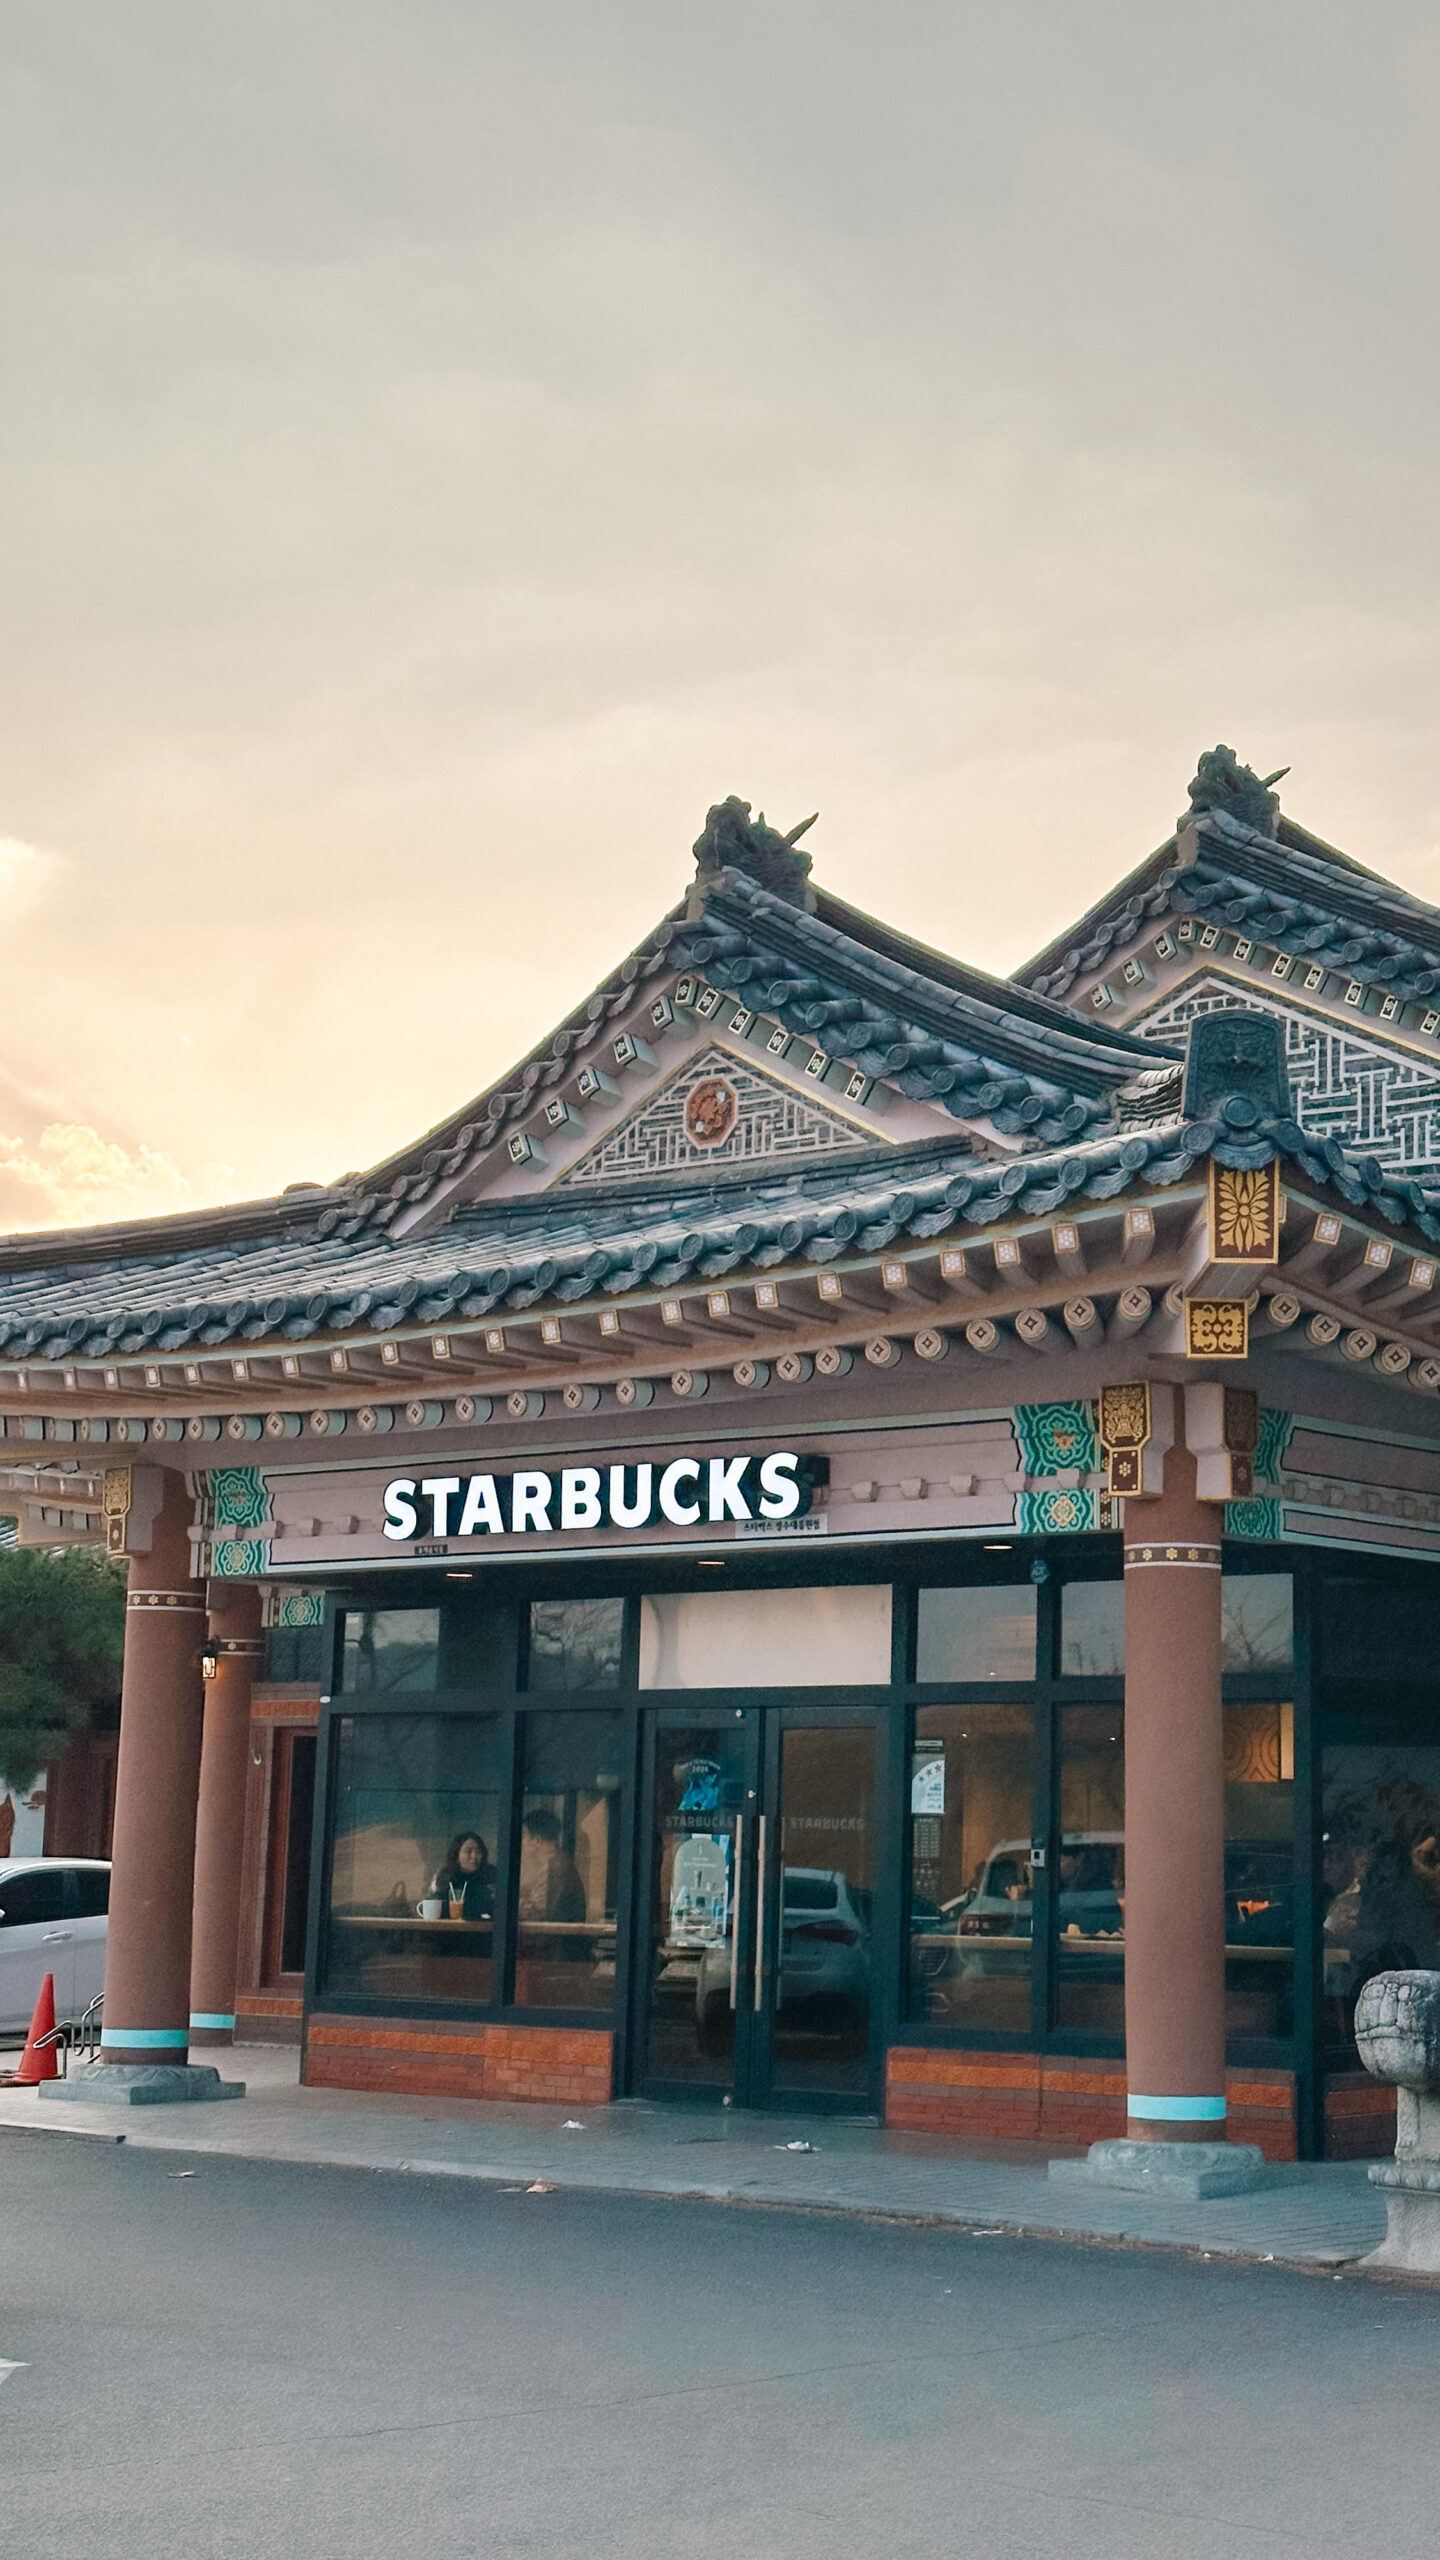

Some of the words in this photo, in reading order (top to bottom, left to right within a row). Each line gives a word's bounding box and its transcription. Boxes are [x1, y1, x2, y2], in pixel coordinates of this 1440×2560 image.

[382, 1451, 800, 1541] STARBUCKS
[743, 1521, 772, 1533] 스타벅스
[664, 1815, 734, 1828] STARBUCKS
[790, 1817, 865, 1831] STARBUCKS
